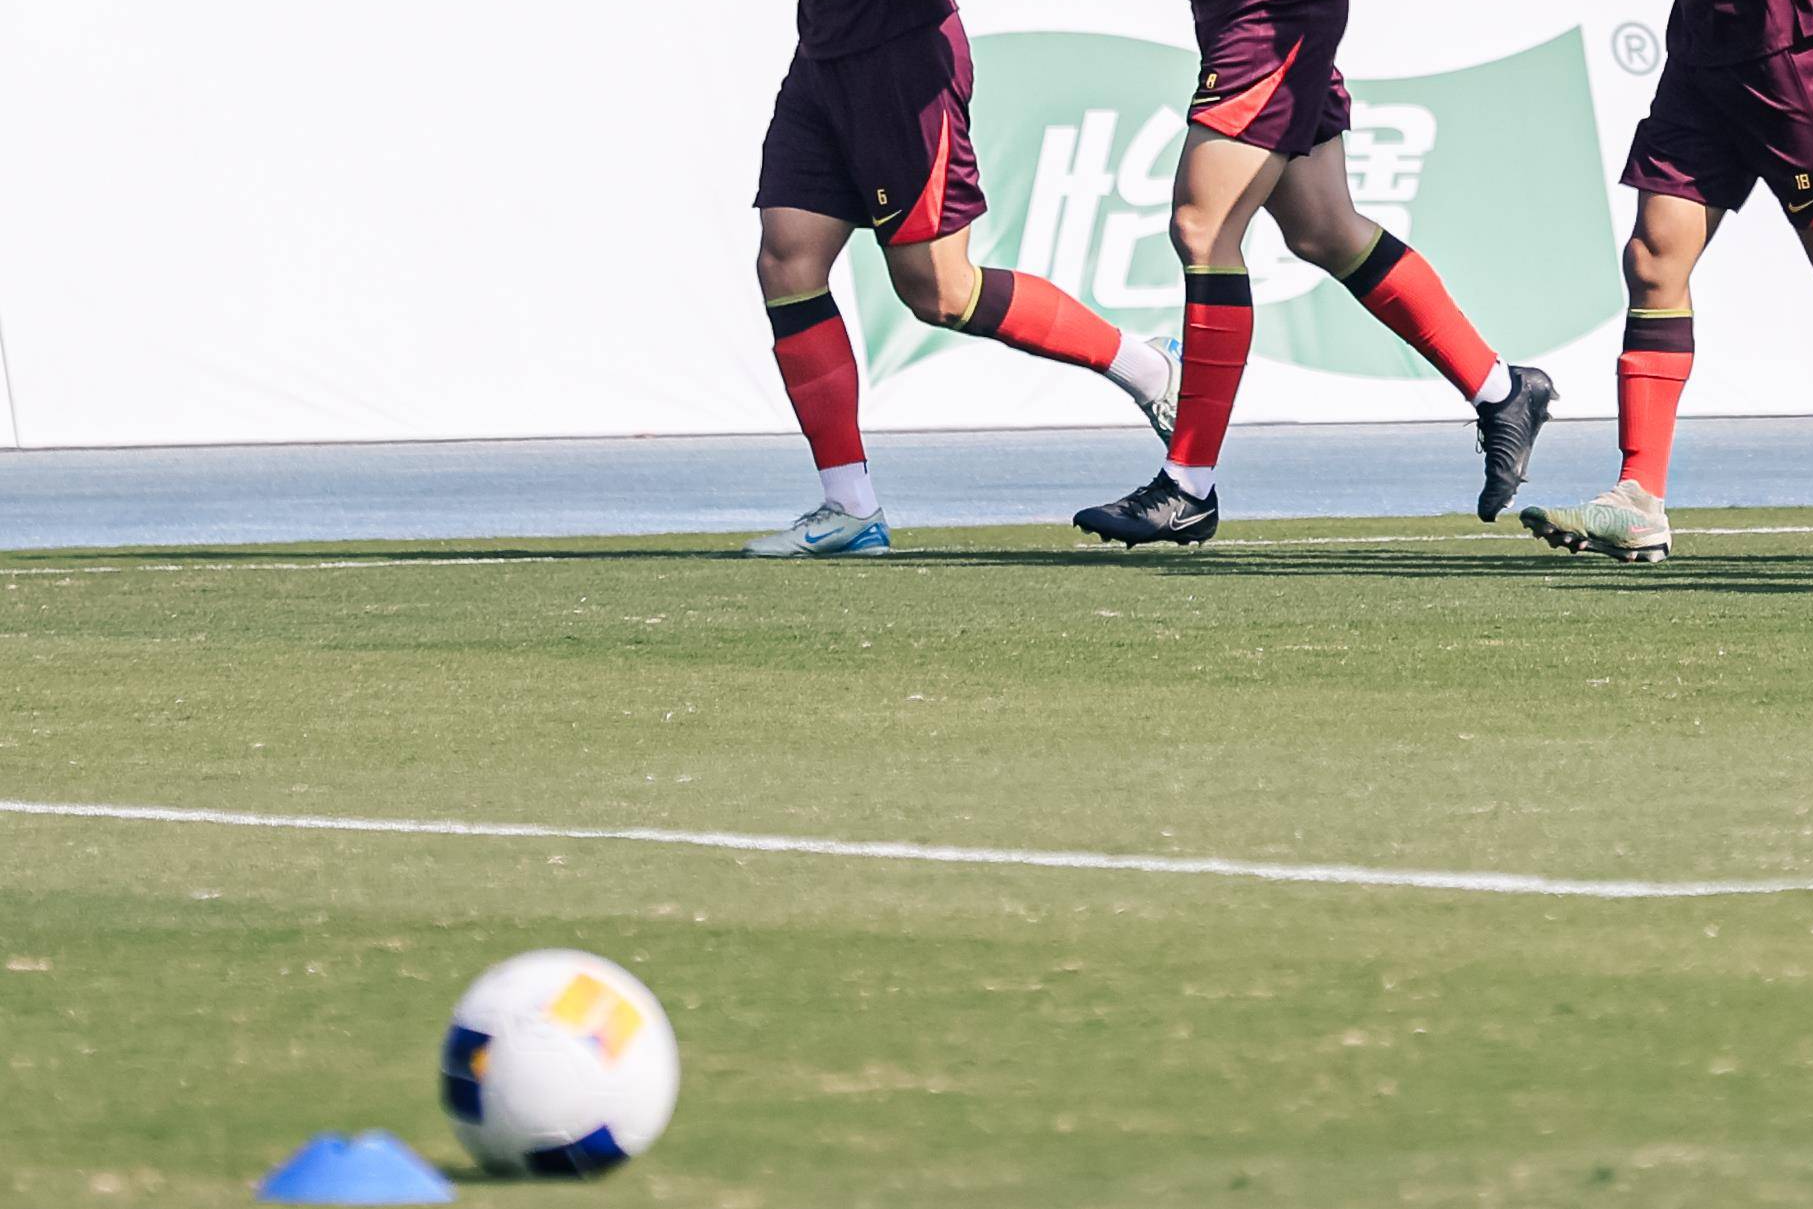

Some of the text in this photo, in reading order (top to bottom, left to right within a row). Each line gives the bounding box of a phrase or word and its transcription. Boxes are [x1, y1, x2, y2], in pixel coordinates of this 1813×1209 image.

[1206, 73, 1217, 89] 8
[1795, 173, 1811, 190] 18
[877, 188, 888, 205] 6
